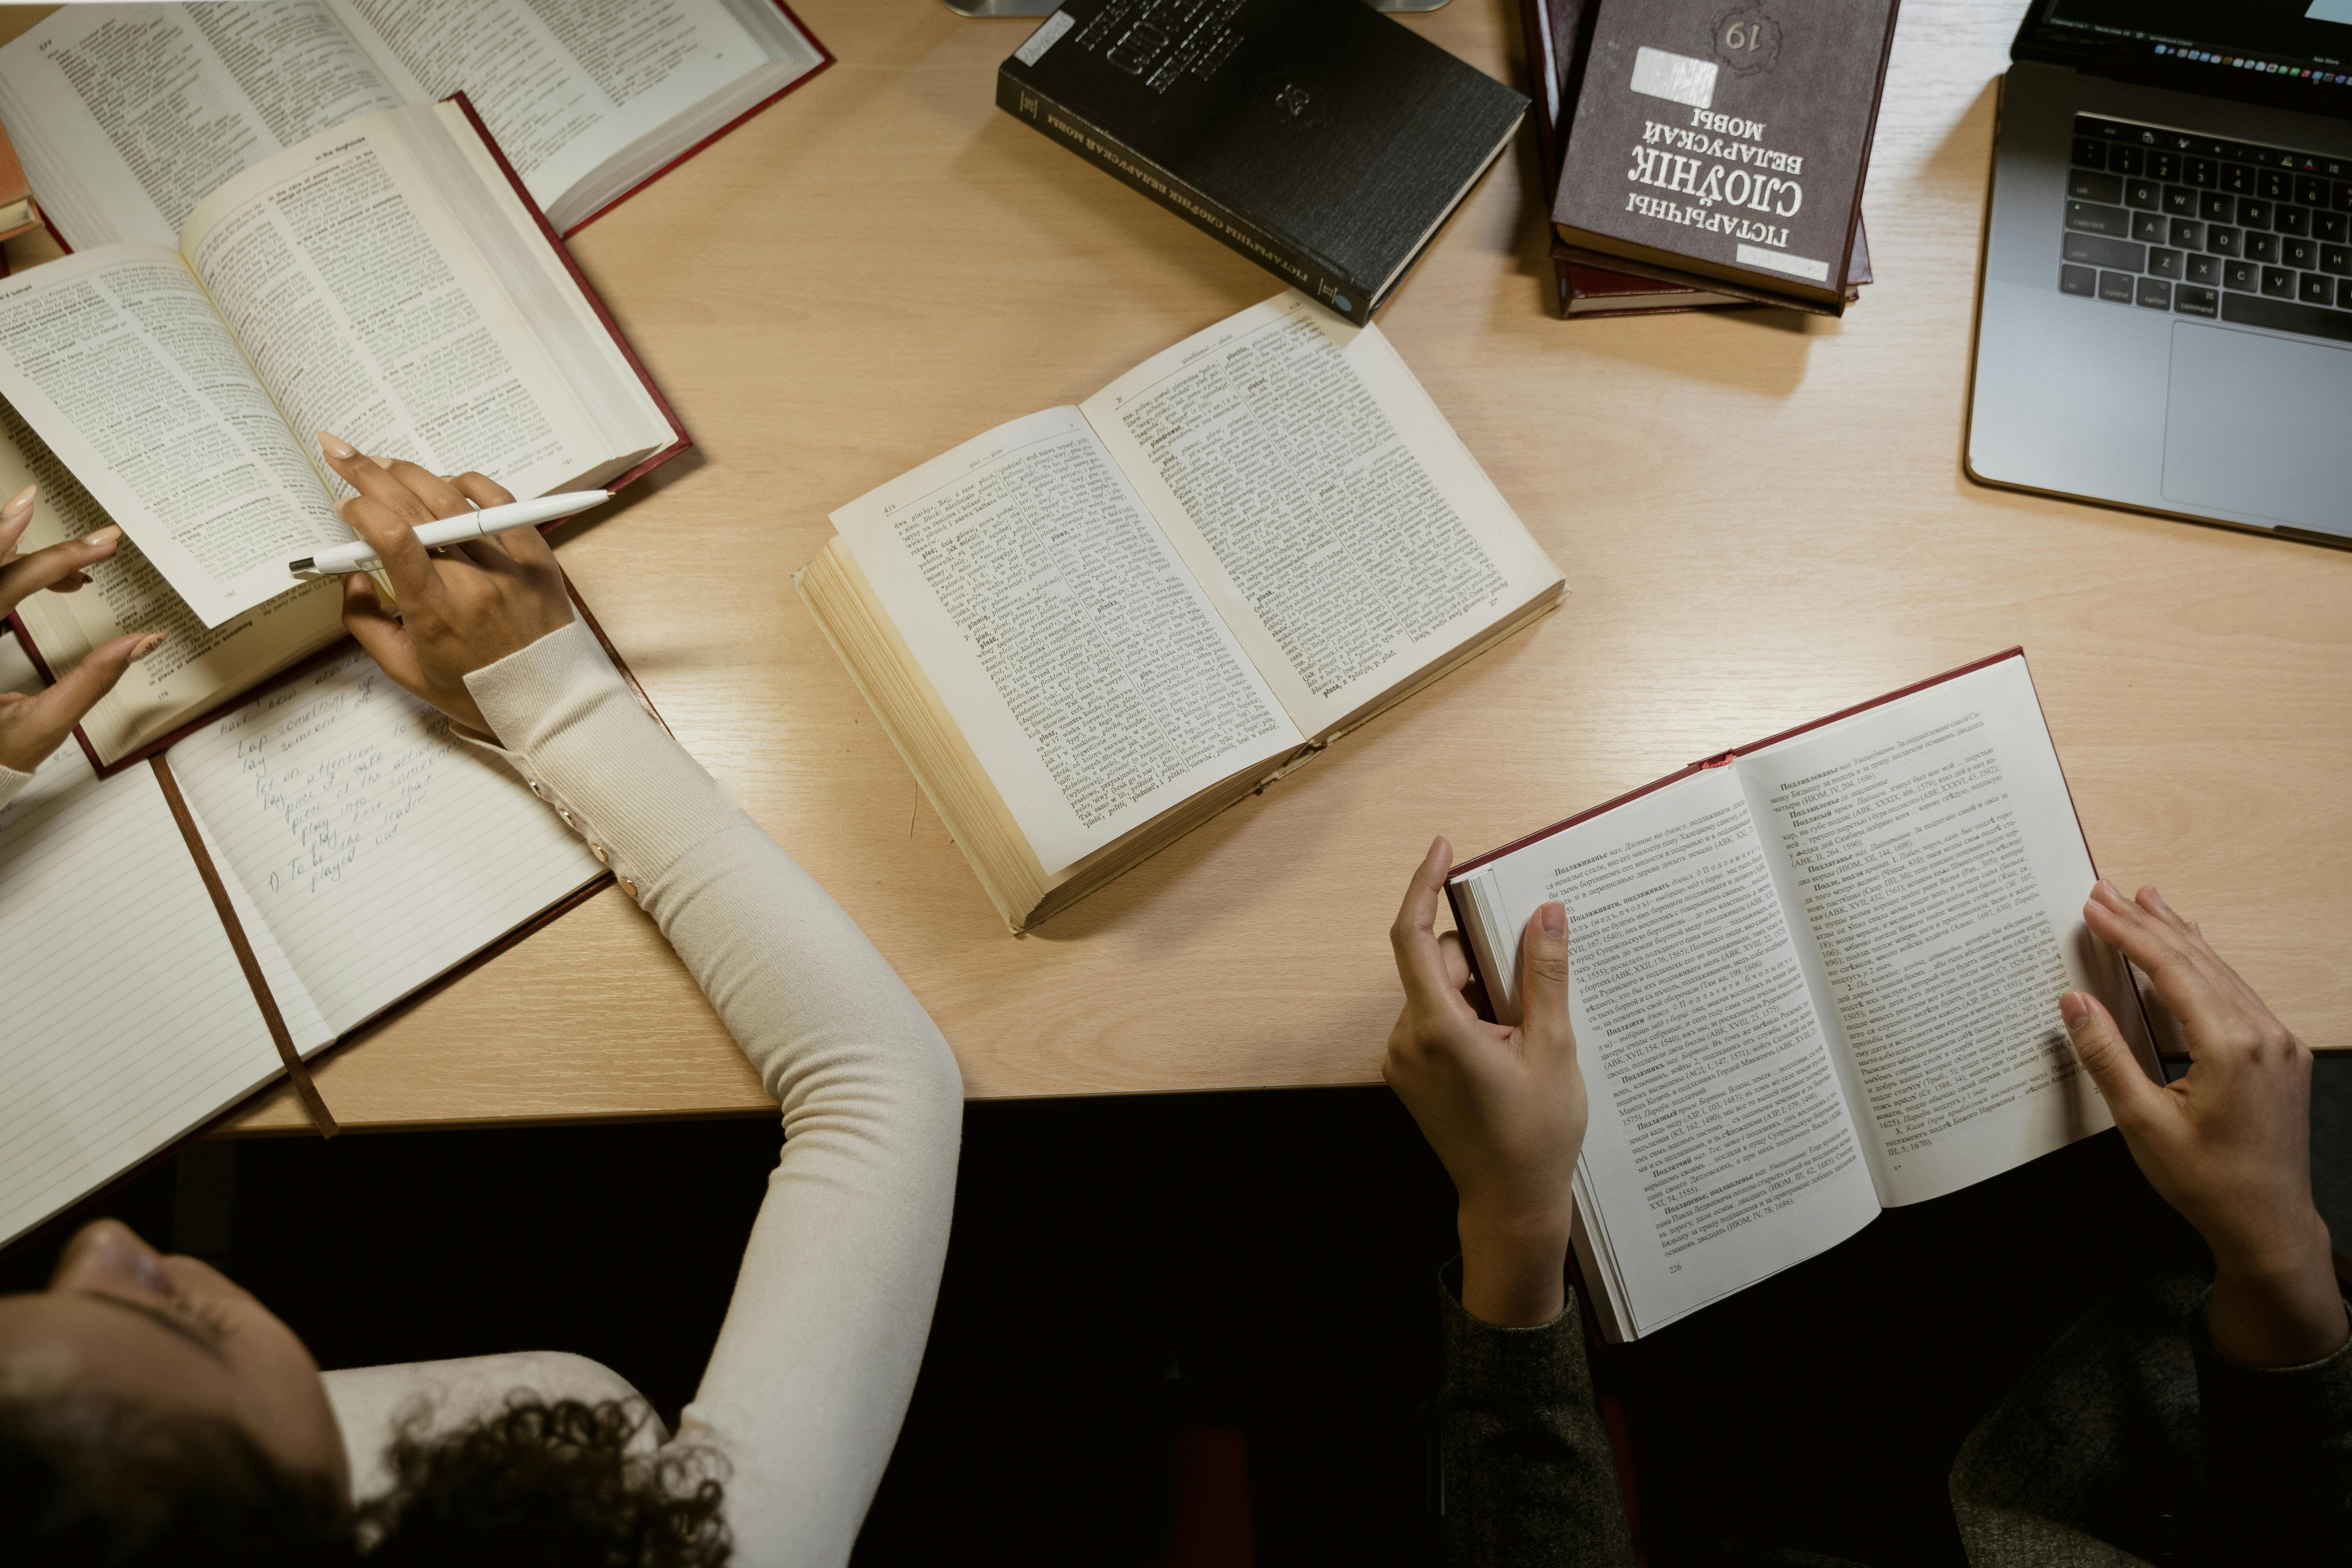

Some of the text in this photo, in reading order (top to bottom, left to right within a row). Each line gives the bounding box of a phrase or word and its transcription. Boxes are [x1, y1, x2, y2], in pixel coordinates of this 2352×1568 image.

[1725, 21, 1762, 52] 19
[1690, 108, 1764, 142] МОВЫ
[1642, 120, 1804, 175] БЕЛАРУСКАЙ
[2124, 160, 2129, 169] 1
[2160, 166, 2167, 176] 2
[1628, 145, 1802, 218] СЛОЎНІК
[2197, 173, 2204, 182] 3
[2234, 179, 2241, 187] 4
[2138, 189, 2147, 200] Q
[2272, 185, 2278, 195] 5
[2174, 196, 2185, 205] W
[2309, 192, 2316, 201] 6
[2214, 202, 2220, 212] E
[2251, 209, 2258, 218] R
[1625, 192, 1790, 247] ГІСТАРЫЧНЫ
[2290, 215, 2295, 224] T
[2145, 223, 2154, 232] A
[2183, 229, 2191, 239] S
[2220, 235, 2229, 245] D
[2258, 242, 2265, 250] F
[2296, 248, 2303, 258] G
[2162, 258, 2171, 268] Z
[2333, 255, 2341, 264] H
[2200, 264, 2207, 274] X
[2237, 270, 2245, 280] C
[2275, 278, 2283, 287] V
[2313, 284, 2320, 293] B
[2180, 302, 2214, 314] command
[437, 419, 450, 428] dark
[452, 409, 469, 420] about
[153, 497, 169, 506] spite
[181, 479, 211, 493] someone
[222, 463, 255, 475] something
[158, 668, 174, 682] place
[1062, 726, 1081, 738] wieku
[1082, 712, 1105, 727] koroną
[1081, 728, 1160, 773] innych Słowian jak nas;
[284, 768, 299, 782] on
[1063, 776, 1105, 801] (wyborowej),
[1140, 741, 1169, 759] rzeczach);
[1070, 790, 1100, 809] prasłowo,
[1098, 765, 1139, 792] przynajmniej
[1158, 748, 1174, 760] pnia:
[1788, 798, 1839, 819] Подлапленье
[1792, 809, 1832, 828] Подласый
[1554, 853, 1607, 876] Подлаживанье
[1609, 848, 1623, 856] наз.
[1625, 837, 1652, 852] Дзеянне
[1664, 824, 1688, 836] дзеясл.
[1554, 872, 1584, 887] немалые
[1584, 864, 1606, 875] стали,
[1607, 859, 1619, 867] яко
[1632, 844, 1661, 858] милости
[1662, 837, 1678, 847] пану
[1679, 824, 1715, 841] Халецкому
[1807, 855, 1853, 873] Подлатанье
[1569, 902, 1622, 924] Подлаживати,
[1623, 883, 1670, 904] подлаживать
[1664, 1169, 1767, 1215] Подлапенье, подлапленье наз.
[1664, 1241, 1696, 1257] осмаковъ
[1697, 1228, 1726, 1244] двадцать
[1727, 1216, 1752, 1232] (ИЮМ,
[1763, 1207, 1774, 1215] 78,
[1775, 1198, 1795, 1210] 1686).
[1669, 1263, 1682, 1274] 226
